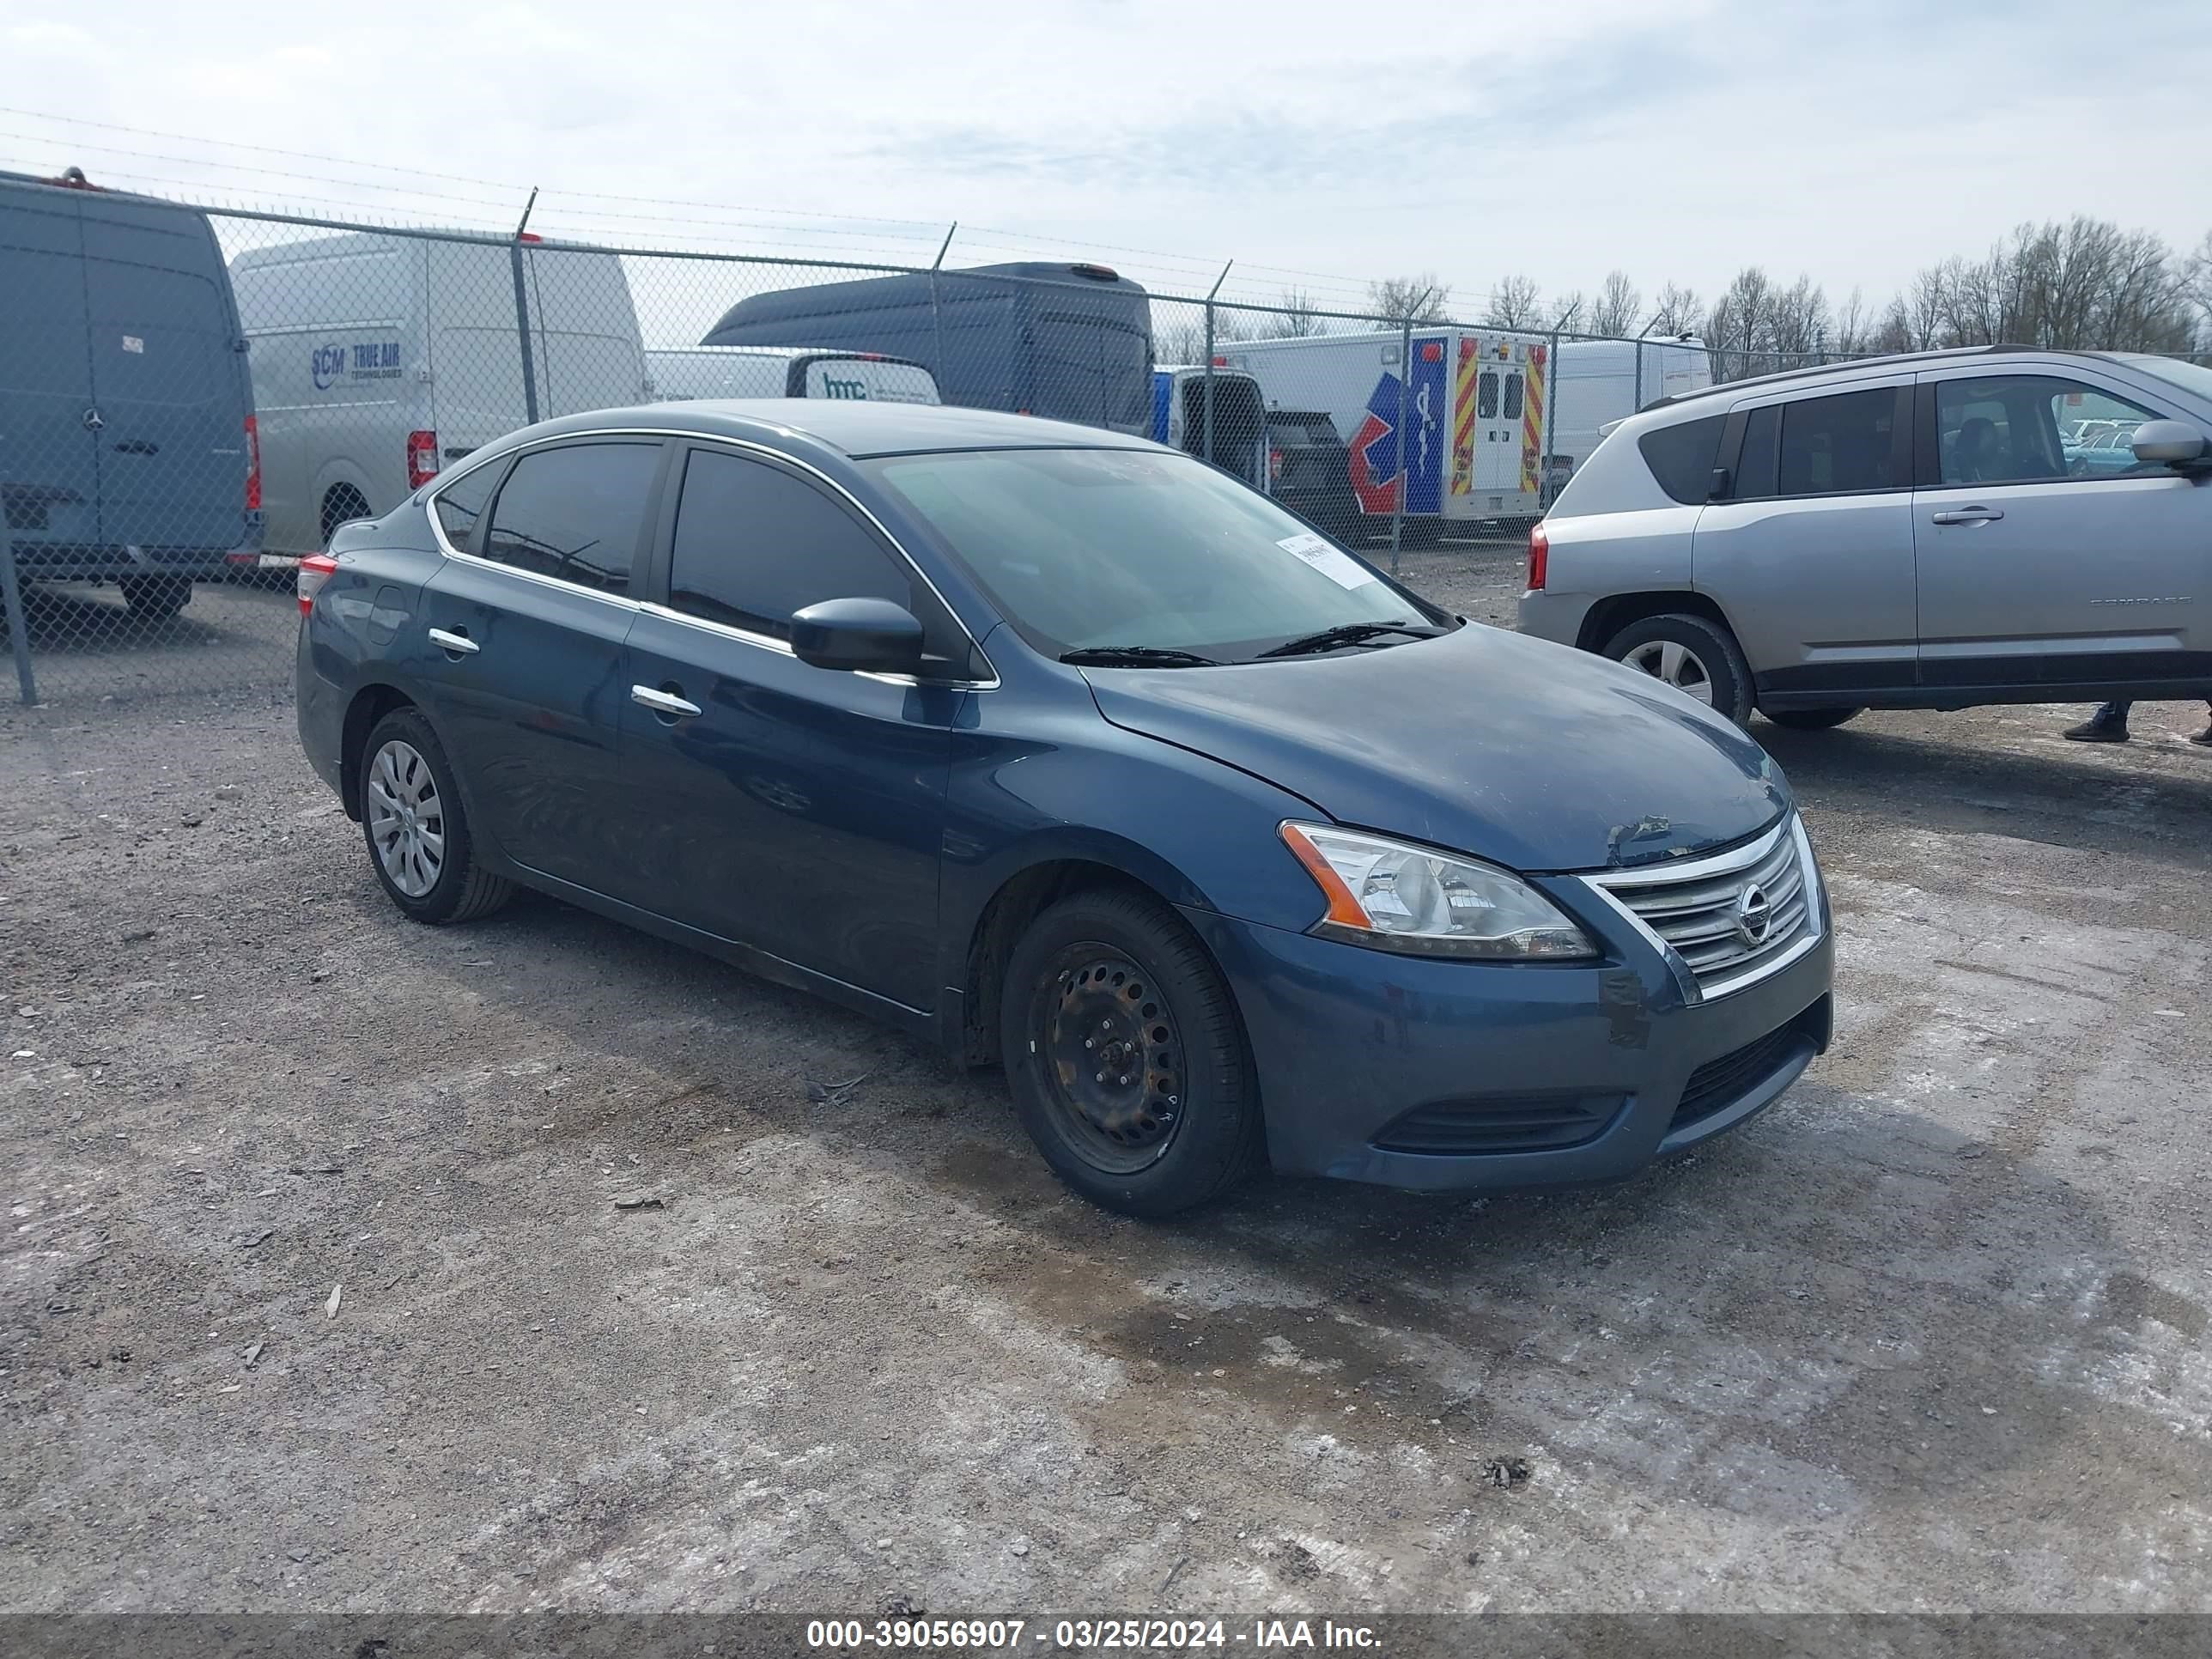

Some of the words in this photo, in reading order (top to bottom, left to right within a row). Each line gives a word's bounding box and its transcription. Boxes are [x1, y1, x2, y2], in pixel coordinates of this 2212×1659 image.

[312, 348, 345, 375] SCM
[354, 344, 379, 368] TRUE
[381, 343, 399, 367] AIR
